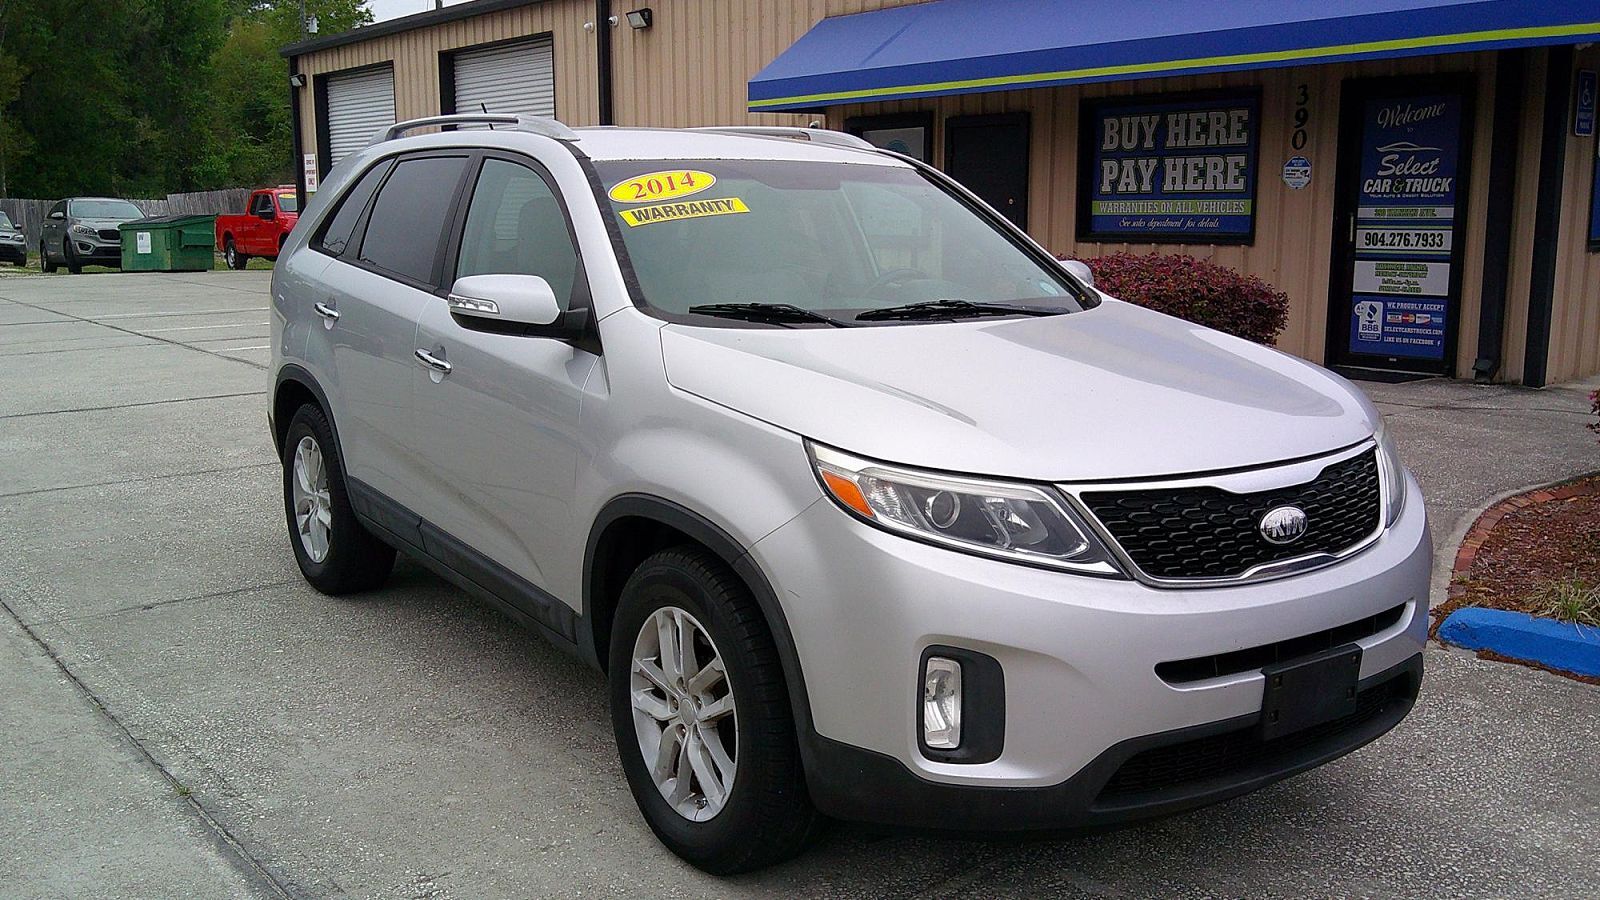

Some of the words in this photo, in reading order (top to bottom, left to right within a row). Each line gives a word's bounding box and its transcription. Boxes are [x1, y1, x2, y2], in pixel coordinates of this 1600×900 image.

[1292, 84, 1309, 150] 390
[1377, 103, 1445, 128] Welcome
[1103, 115, 1160, 150] BUY
[1166, 110, 1249, 147] HERE
[1101, 159, 1158, 192] PAY
[1164, 156, 1246, 190] HERE
[1377, 154, 1440, 176] Select
[629, 172, 696, 199] 2014
[1363, 178, 1392, 193] CAR
[1392, 178, 1404, 193] &
[1405, 177, 1453, 193] TRUCK
[631, 200, 735, 222] WARRANTY
[1100, 202, 1158, 213] WARRANTIES
[1160, 202, 1174, 213] ON
[1175, 202, 1194, 213] ALL
[1197, 202, 1245, 213] VEHICLES
[1184, 218, 1196, 230] for
[1364, 232, 1444, 248] 904.276.7933
[1396, 302, 1421, 310] PROUDLY
[1422, 303, 1445, 311] ACCEPT
[1361, 324, 1379, 332] BBB
